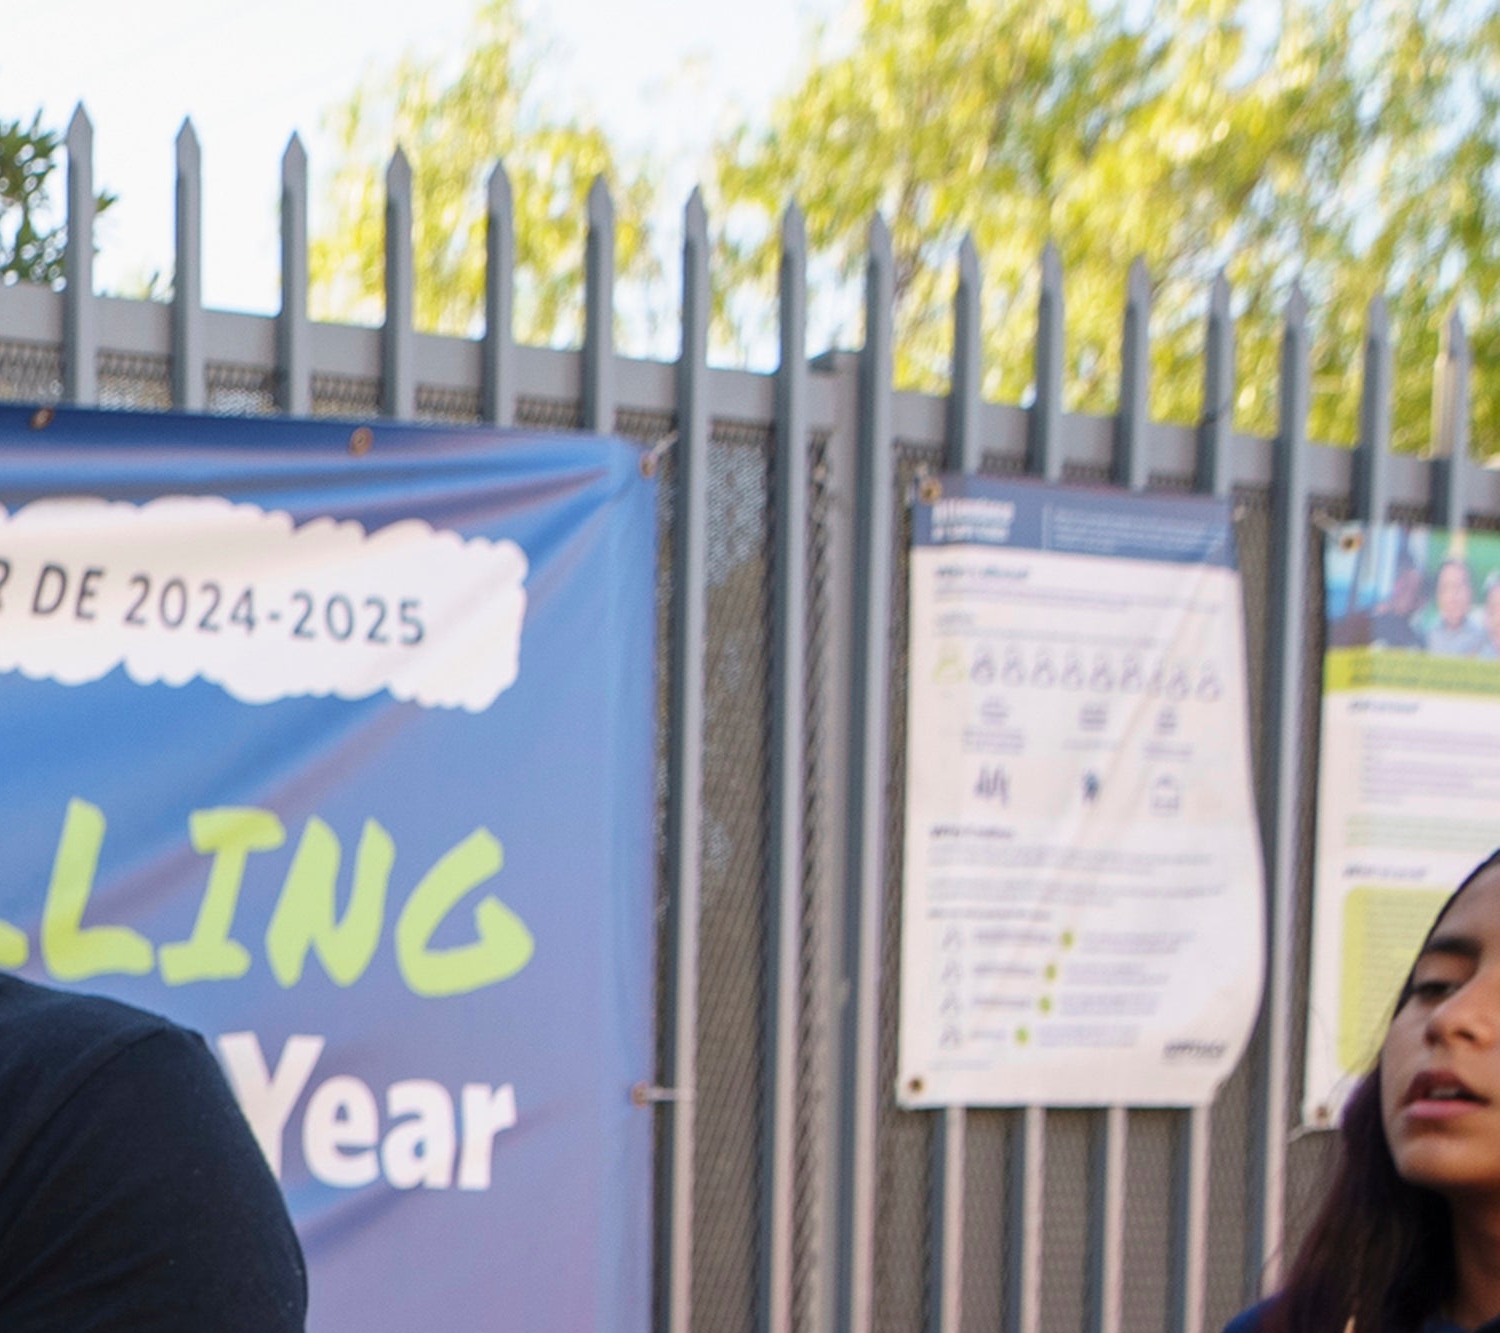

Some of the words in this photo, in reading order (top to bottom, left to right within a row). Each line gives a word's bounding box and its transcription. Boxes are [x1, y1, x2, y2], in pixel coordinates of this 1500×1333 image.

[31, 563, 105, 620] DE
[122, 574, 426, 647] 2024-2025
[216, 1030, 519, 1191] Year
